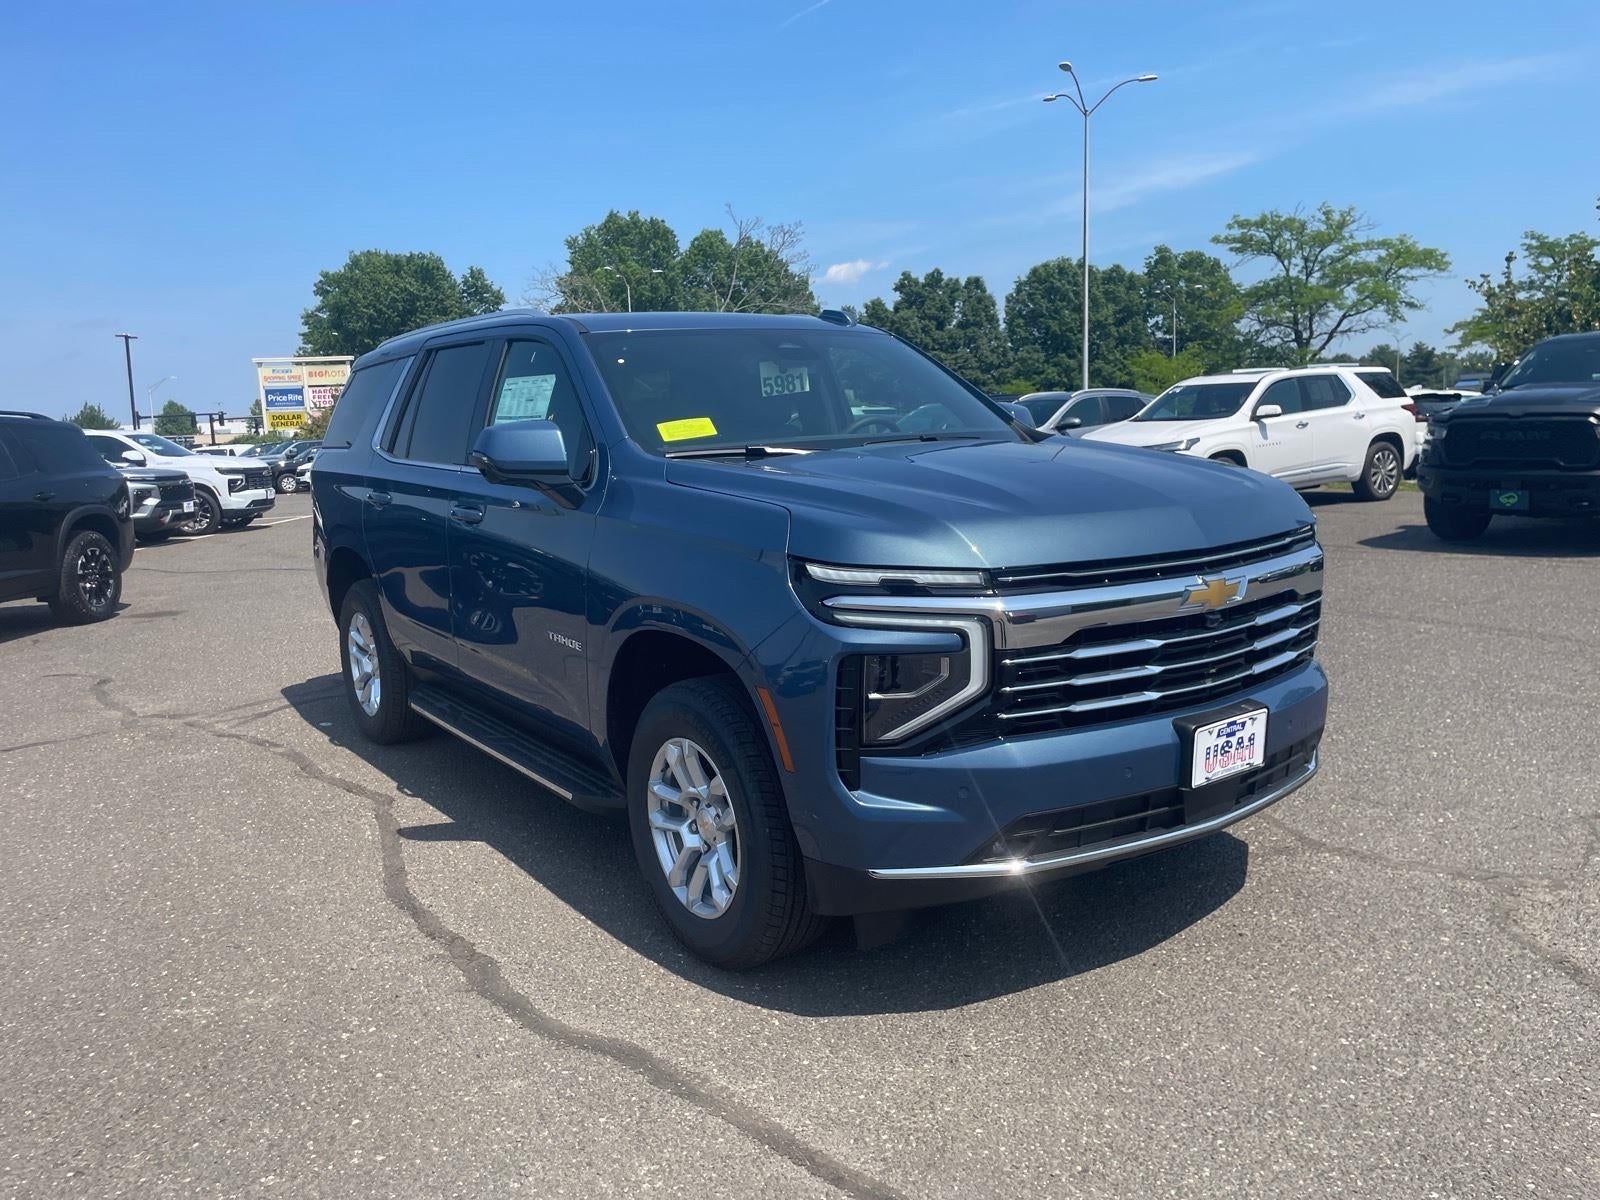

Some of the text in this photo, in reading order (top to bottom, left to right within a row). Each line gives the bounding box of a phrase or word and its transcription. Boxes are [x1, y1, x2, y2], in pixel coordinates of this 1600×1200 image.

[762, 372, 805, 396] 5981
[546, 630, 583, 652] TAHOE
[1219, 723, 1243, 736] CENTRAL
